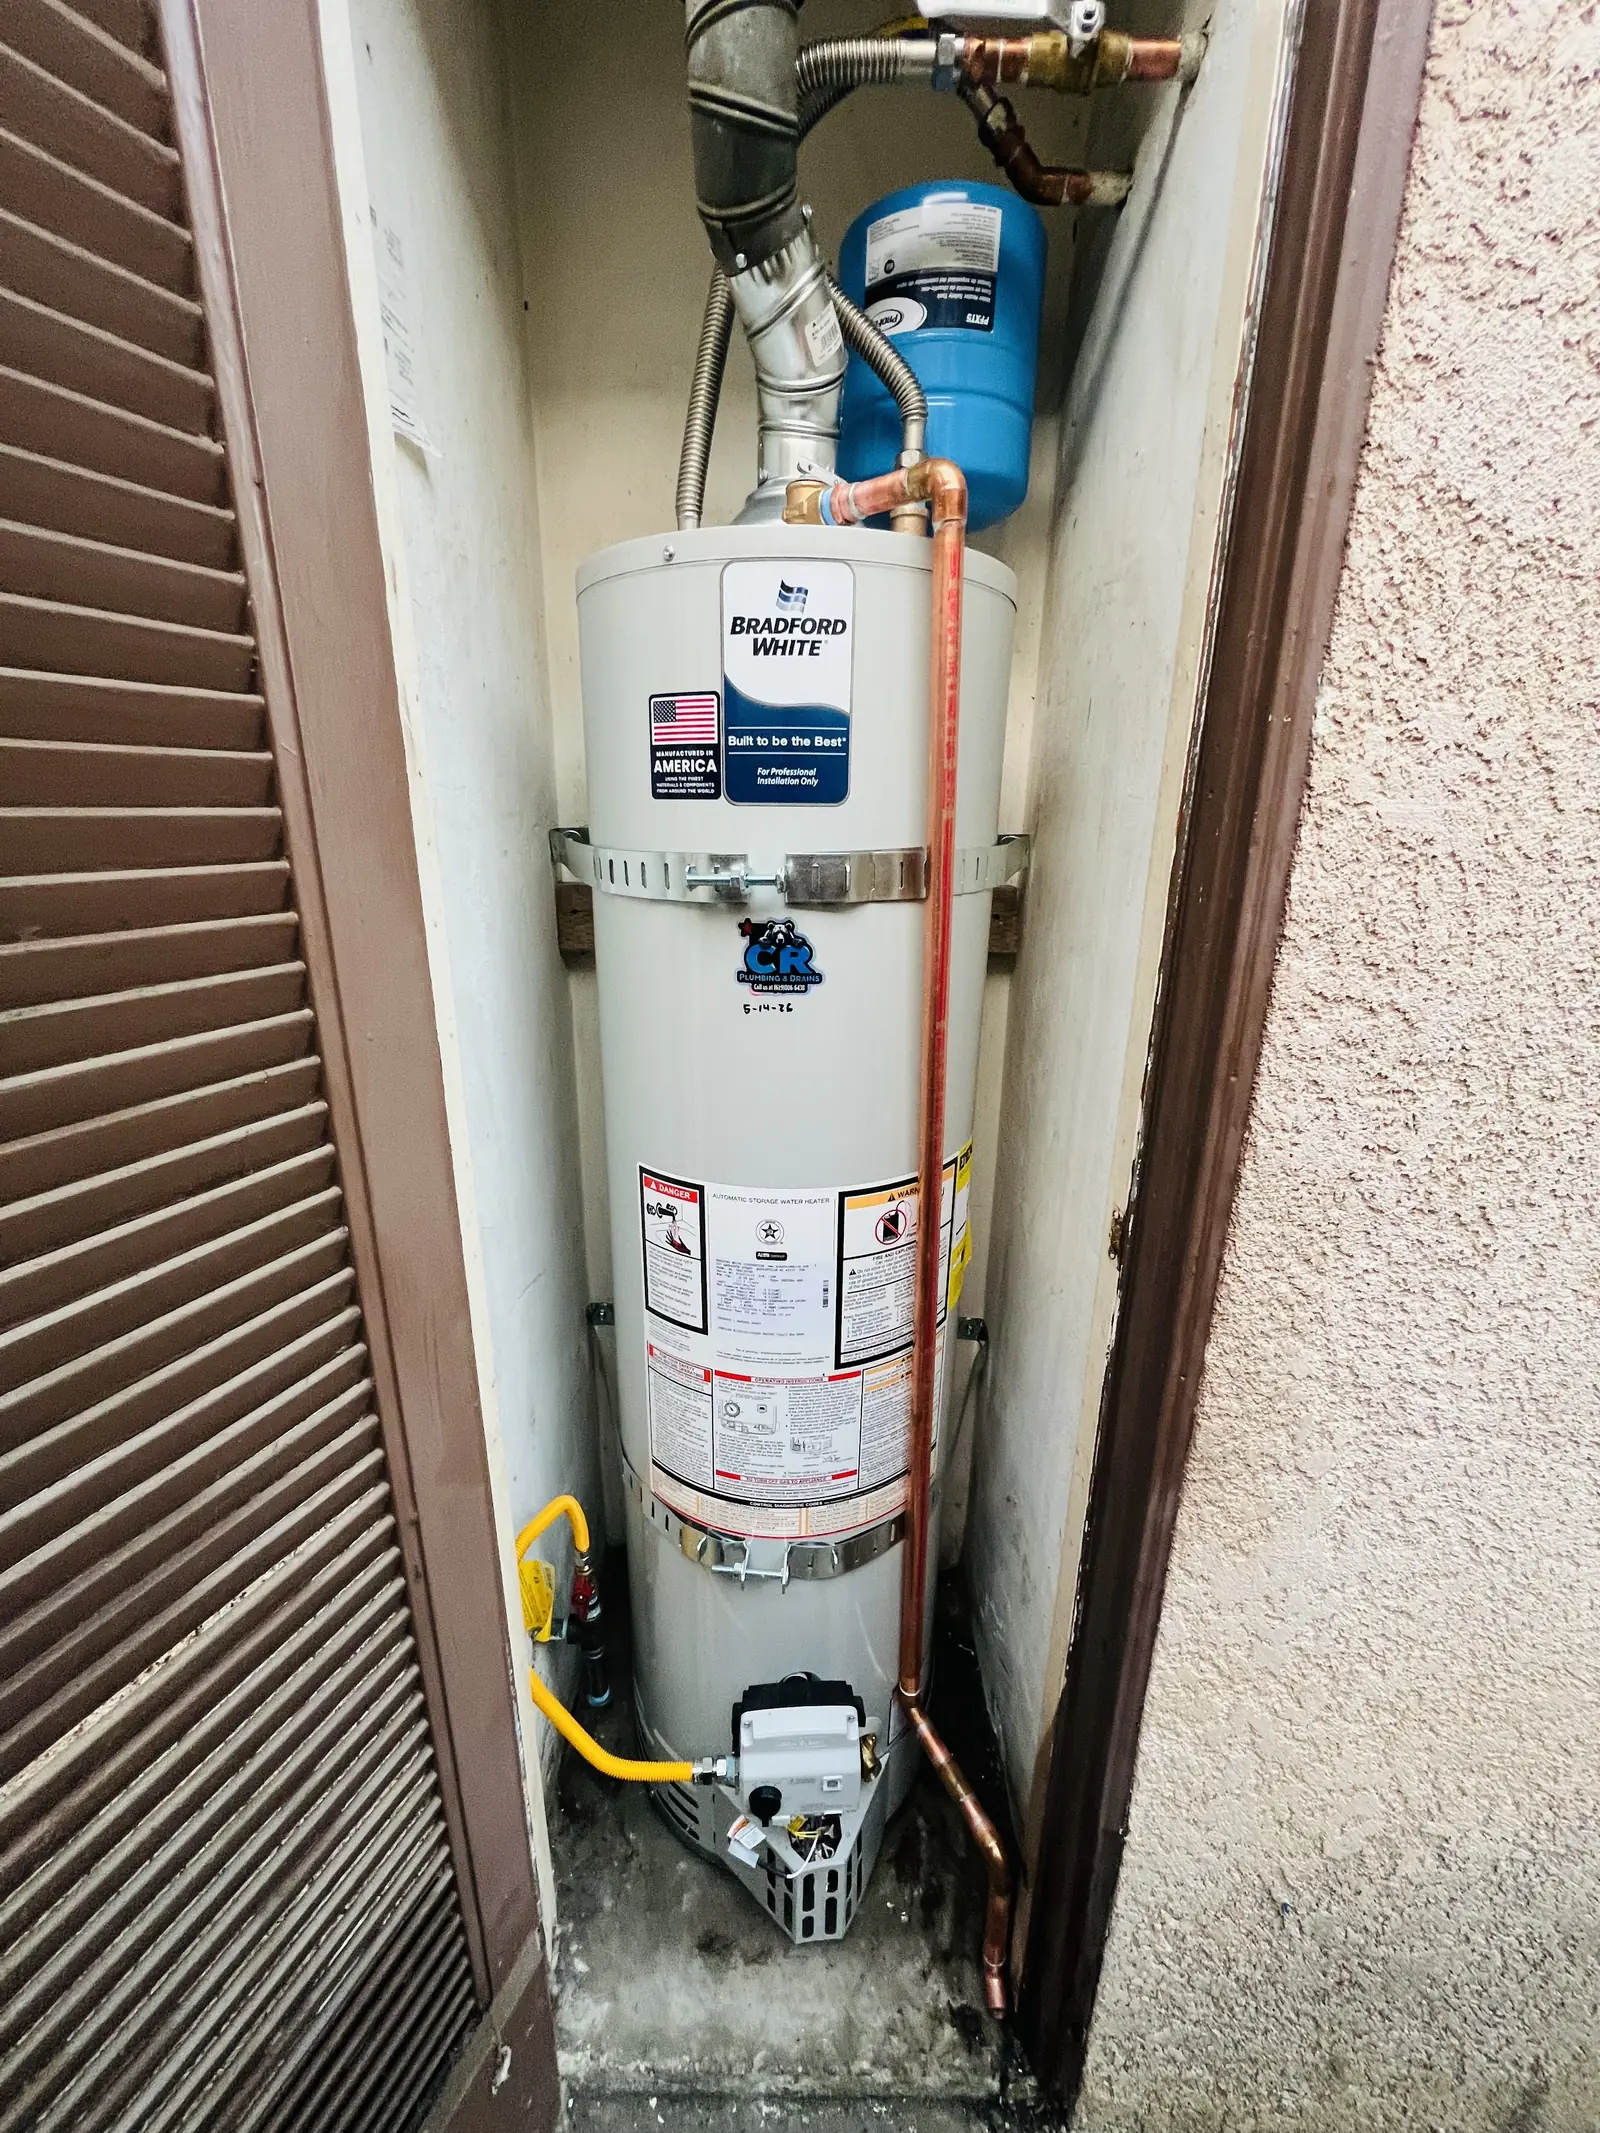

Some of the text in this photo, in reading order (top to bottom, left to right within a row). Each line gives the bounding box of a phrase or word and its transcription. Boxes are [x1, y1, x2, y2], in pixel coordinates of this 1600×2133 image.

[730, 617, 847, 635] BRADFORD
[752, 638, 821, 656] WHITE
[728, 736, 753, 746] Built
[757, 736, 768, 746] to
[772, 736, 787, 746] be
[792, 736, 810, 746] the
[654, 759, 717, 773] AMERICA
[771, 768, 816, 776] Professional
[757, 777, 818, 787] Installation Only
[746, 944, 812, 974] CR
[739, 973, 780, 982] PLUMBING
[743, 1003, 793, 1014] 5-14-26
[659, 1184, 690, 1200] DANGER
[897, 1187, 919, 1198] WARN
[713, 1193, 747, 1203] AUTOMATIC
